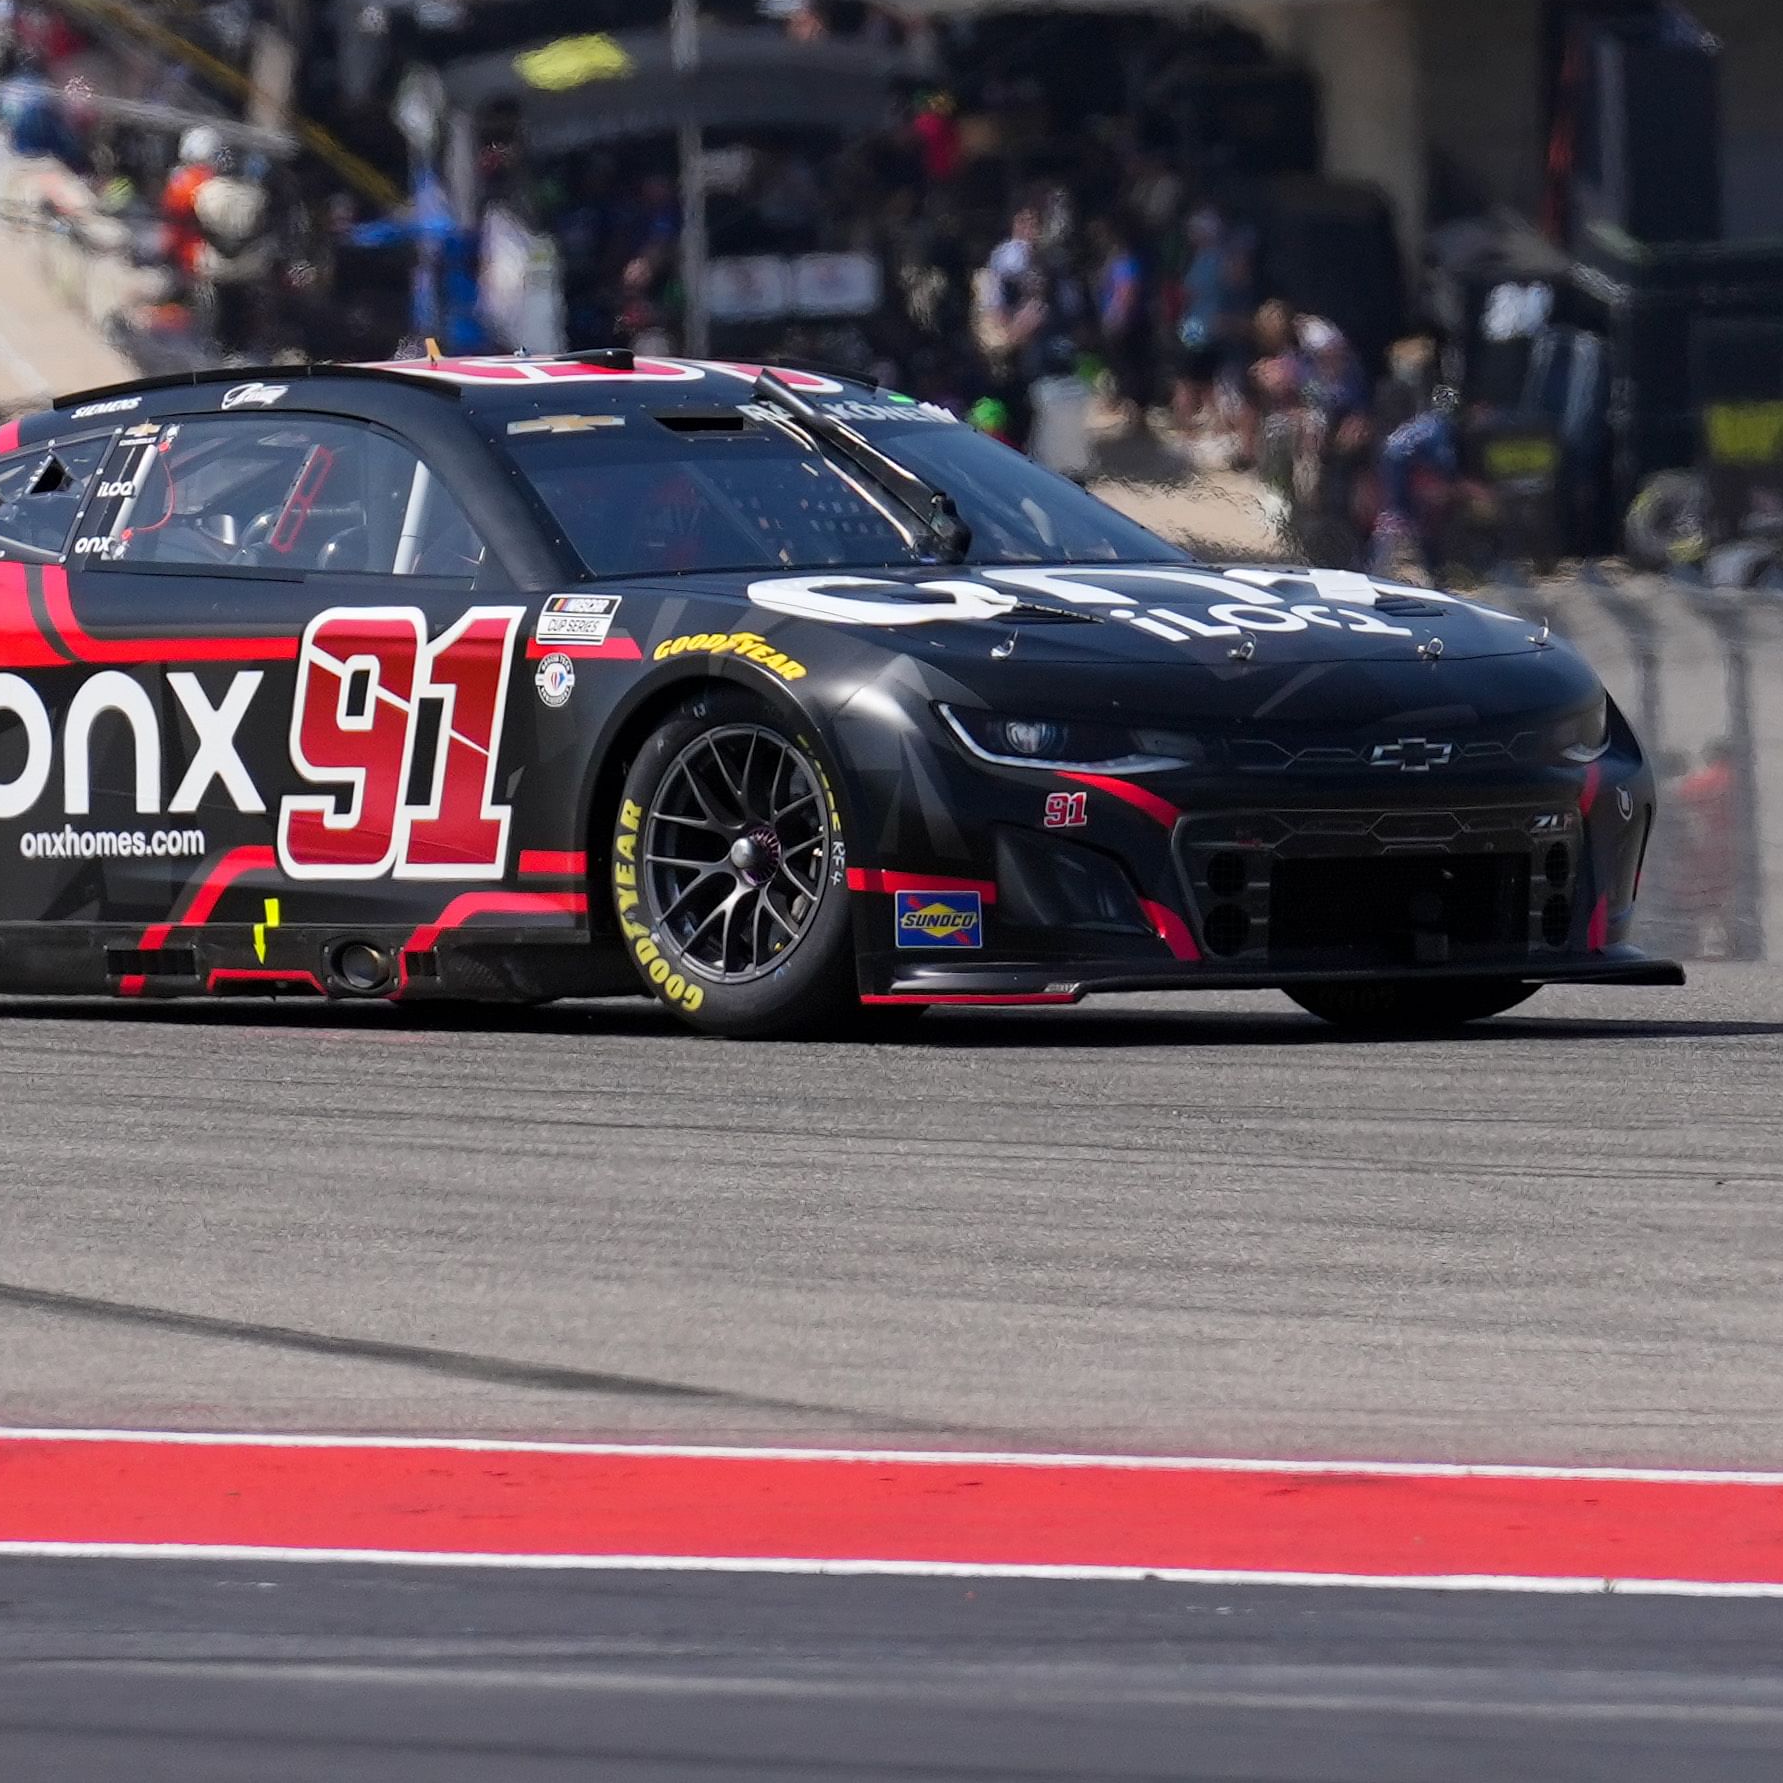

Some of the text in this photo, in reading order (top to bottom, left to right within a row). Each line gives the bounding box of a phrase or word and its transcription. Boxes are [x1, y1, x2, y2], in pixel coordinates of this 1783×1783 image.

[71, 396, 143, 419] SIEMENS
[653, 632, 808, 681] GOODYEAR
[277, 605, 527, 880] 91
[1044, 792, 1086, 828] 91
[19, 824, 206, 859] onxhomes.com
[614, 799, 706, 1012] GOODYEAR
[904, 913, 975, 928] SUNOCO
